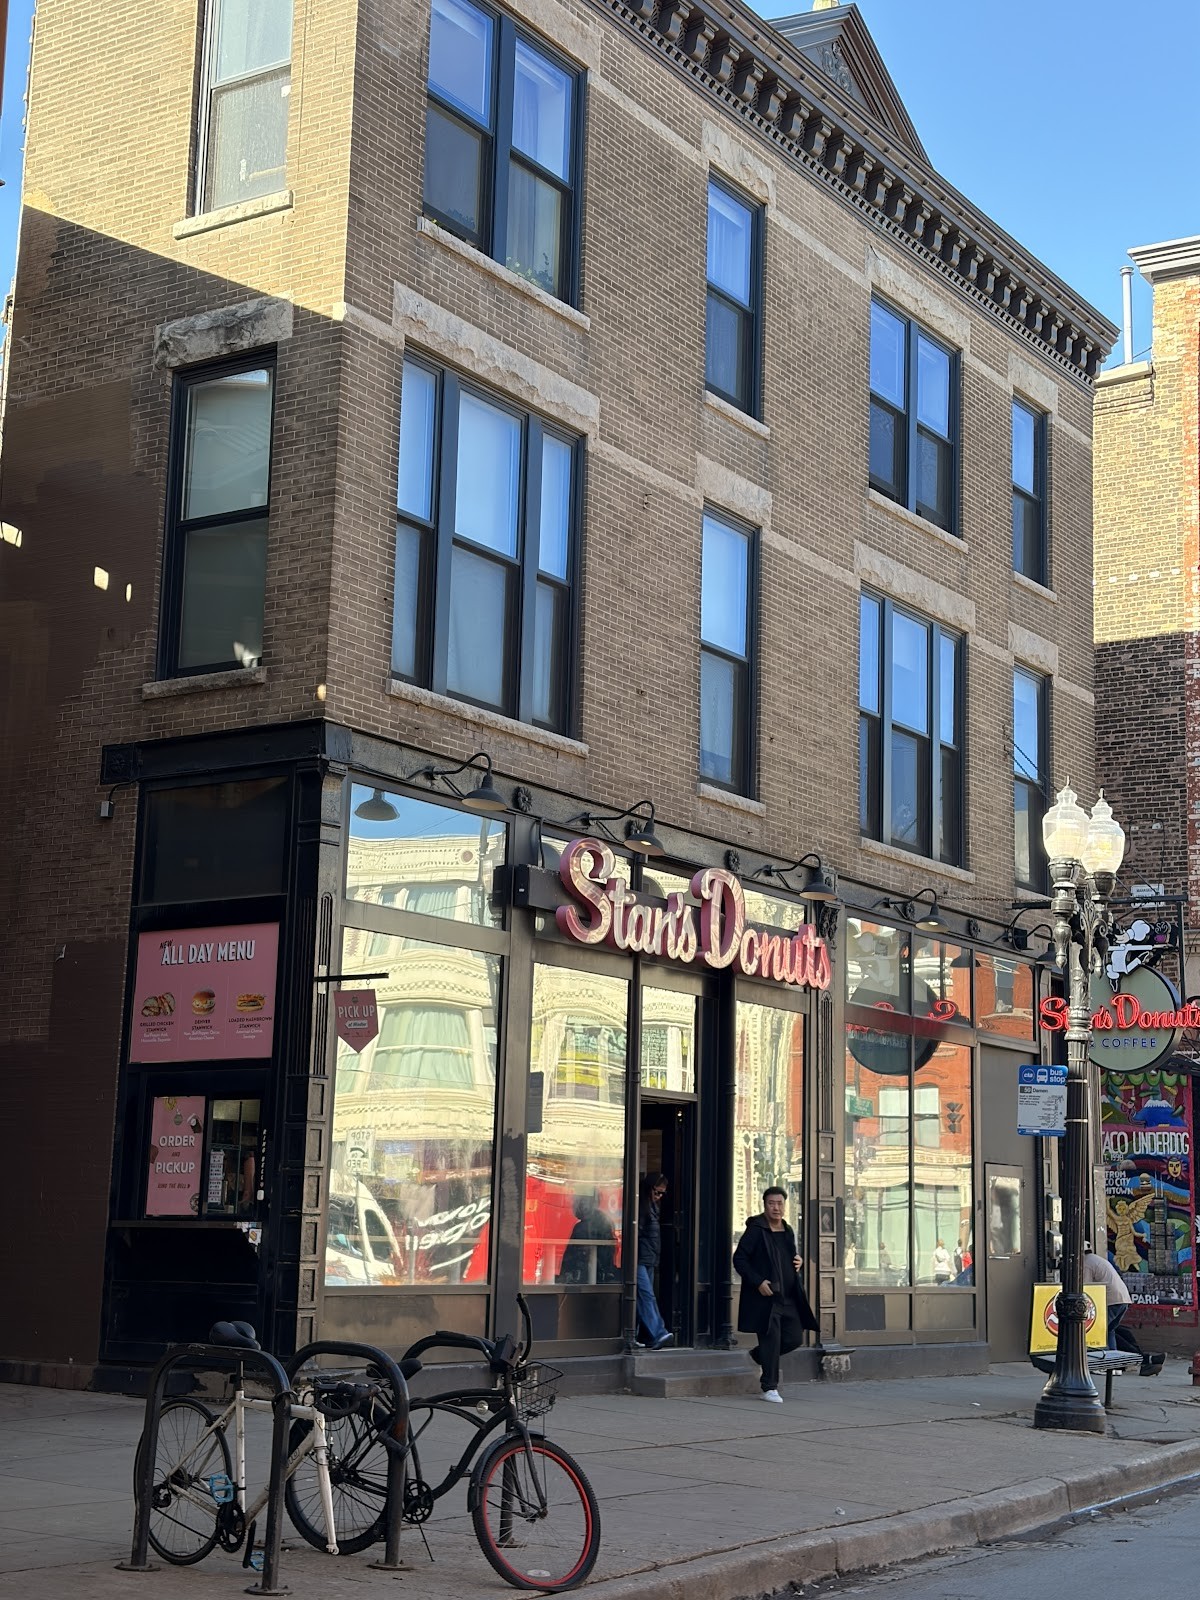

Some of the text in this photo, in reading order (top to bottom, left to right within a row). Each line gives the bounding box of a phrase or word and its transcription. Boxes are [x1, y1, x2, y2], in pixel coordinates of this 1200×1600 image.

[556, 837, 831, 990] Stan's Donuts
[160, 939, 174, 949] NEW
[161, 940, 256, 966] ALL DAY MENU
[338, 1004, 376, 1018] PICK UP
[1039, 997, 1113, 1031] Stn's
[1102, 1038, 1156, 1048] COFFEE
[1050, 1076, 1066, 1084] stop
[159, 1135, 196, 1148] ORDER
[1133, 1131, 1190, 1155] UNDERDOG
[155, 1161, 196, 1174] PICKUP
[1105, 1170, 1126, 1178] FROM
[1115, 1178, 1131, 1186] CITY
[1105, 1187, 1133, 1195] HITOWN
[1131, 1293, 1159, 1304] PARK
